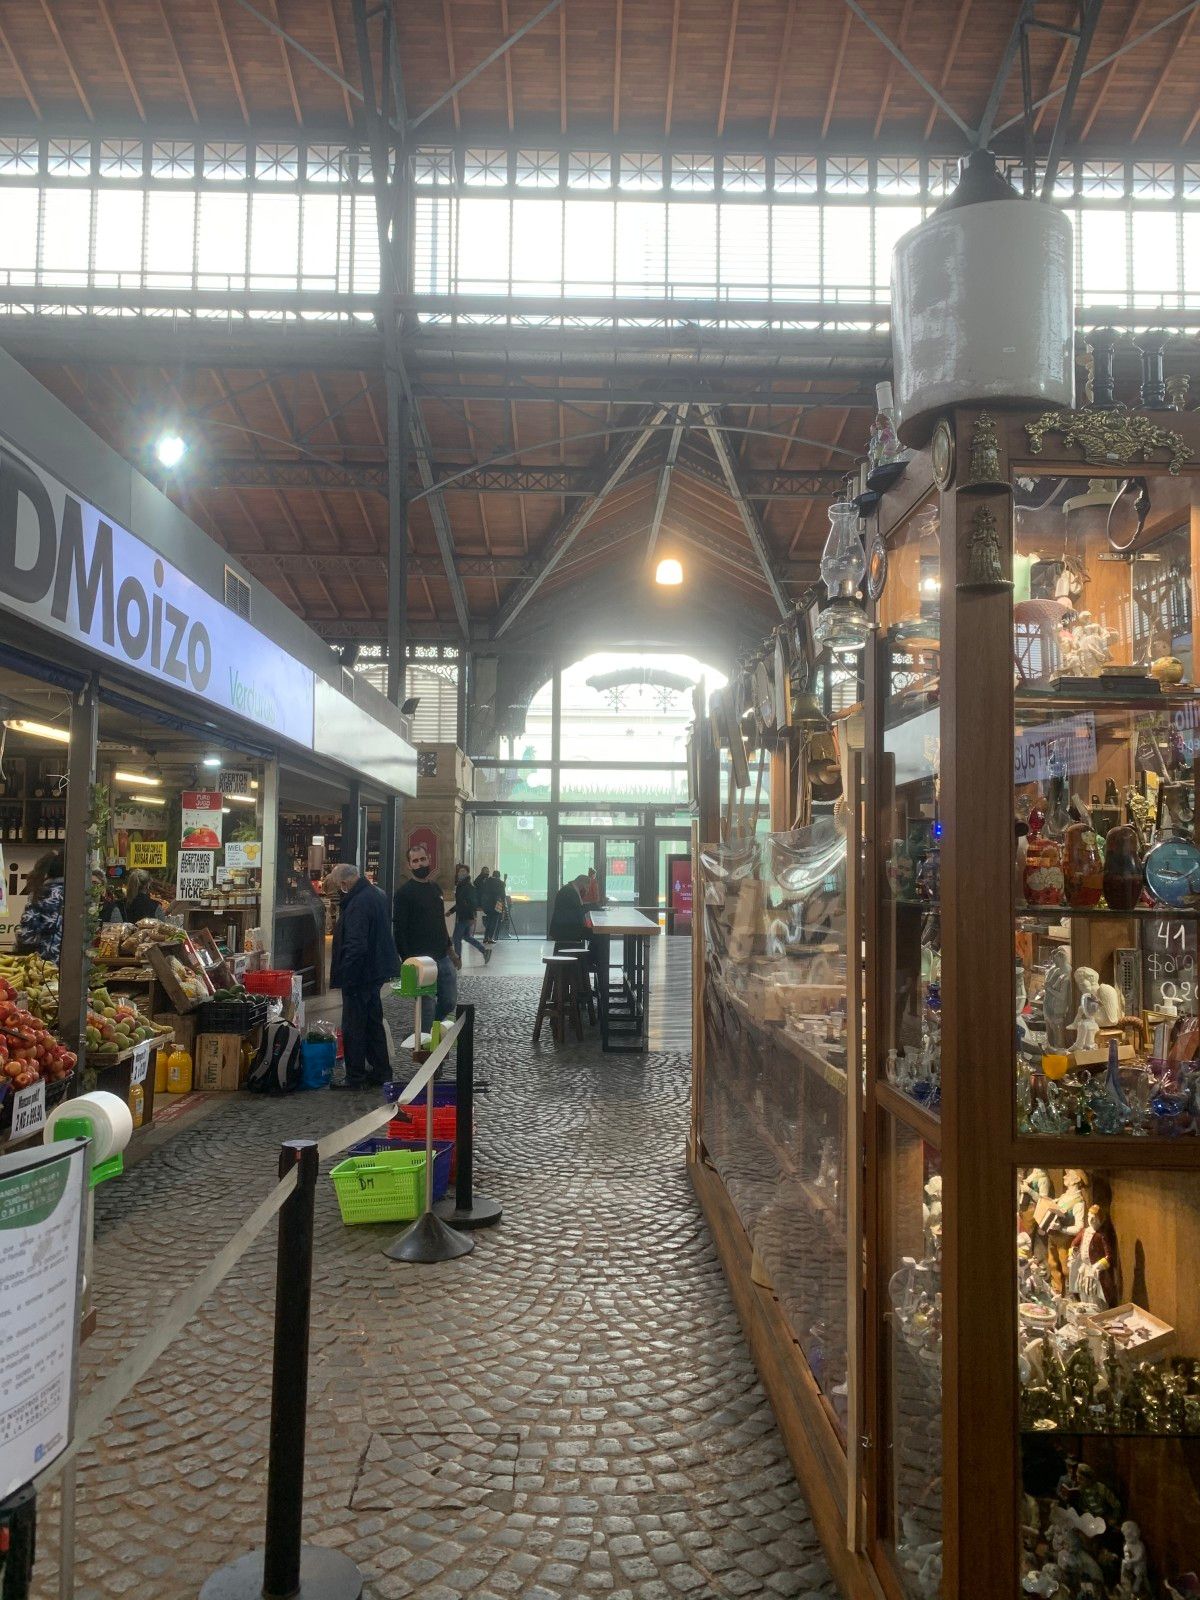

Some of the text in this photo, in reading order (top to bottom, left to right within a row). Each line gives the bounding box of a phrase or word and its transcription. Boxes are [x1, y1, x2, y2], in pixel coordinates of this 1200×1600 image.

[219, 772, 248, 782] OFERTON
[227, 844, 242, 852] MIEL
[134, 853, 163, 865] AVISAR ANTES
[181, 853, 210, 862] ACEPTAMOS
[1158, 921, 1186, 950] 41
[207, 1063, 218, 1084] JUAN
